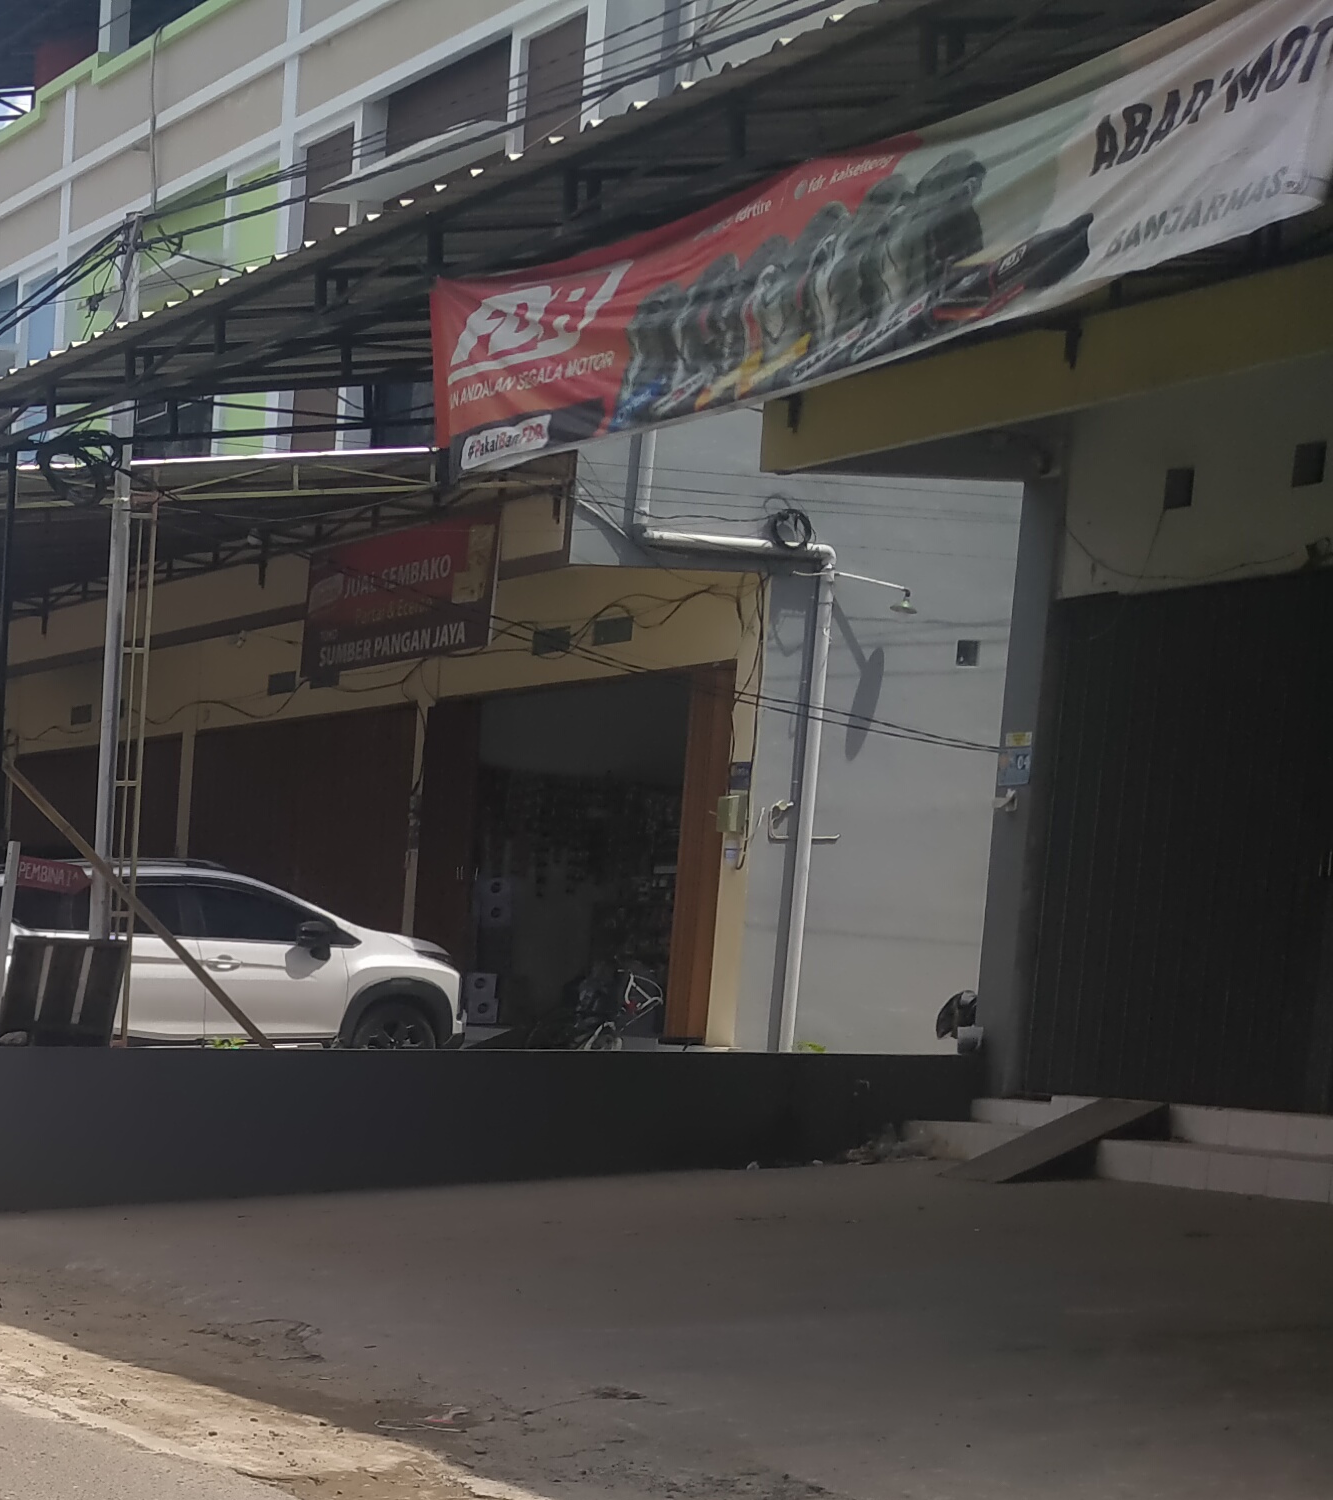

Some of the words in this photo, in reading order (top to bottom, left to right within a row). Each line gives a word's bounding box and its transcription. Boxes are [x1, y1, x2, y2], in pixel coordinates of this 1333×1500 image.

[459, 377, 517, 405] ANDALAN
[517, 364, 563, 391] SEGALA
[564, 350, 616, 379] MOTOR
[344, 571, 377, 599] JUAL
[381, 554, 452, 590] SEMBAKO
[319, 638, 372, 668] SUMBER
[373, 627, 431, 658] PANGAN
[432, 621, 466, 647] JAYA
[18, 861, 65, 885] PEMBINA
